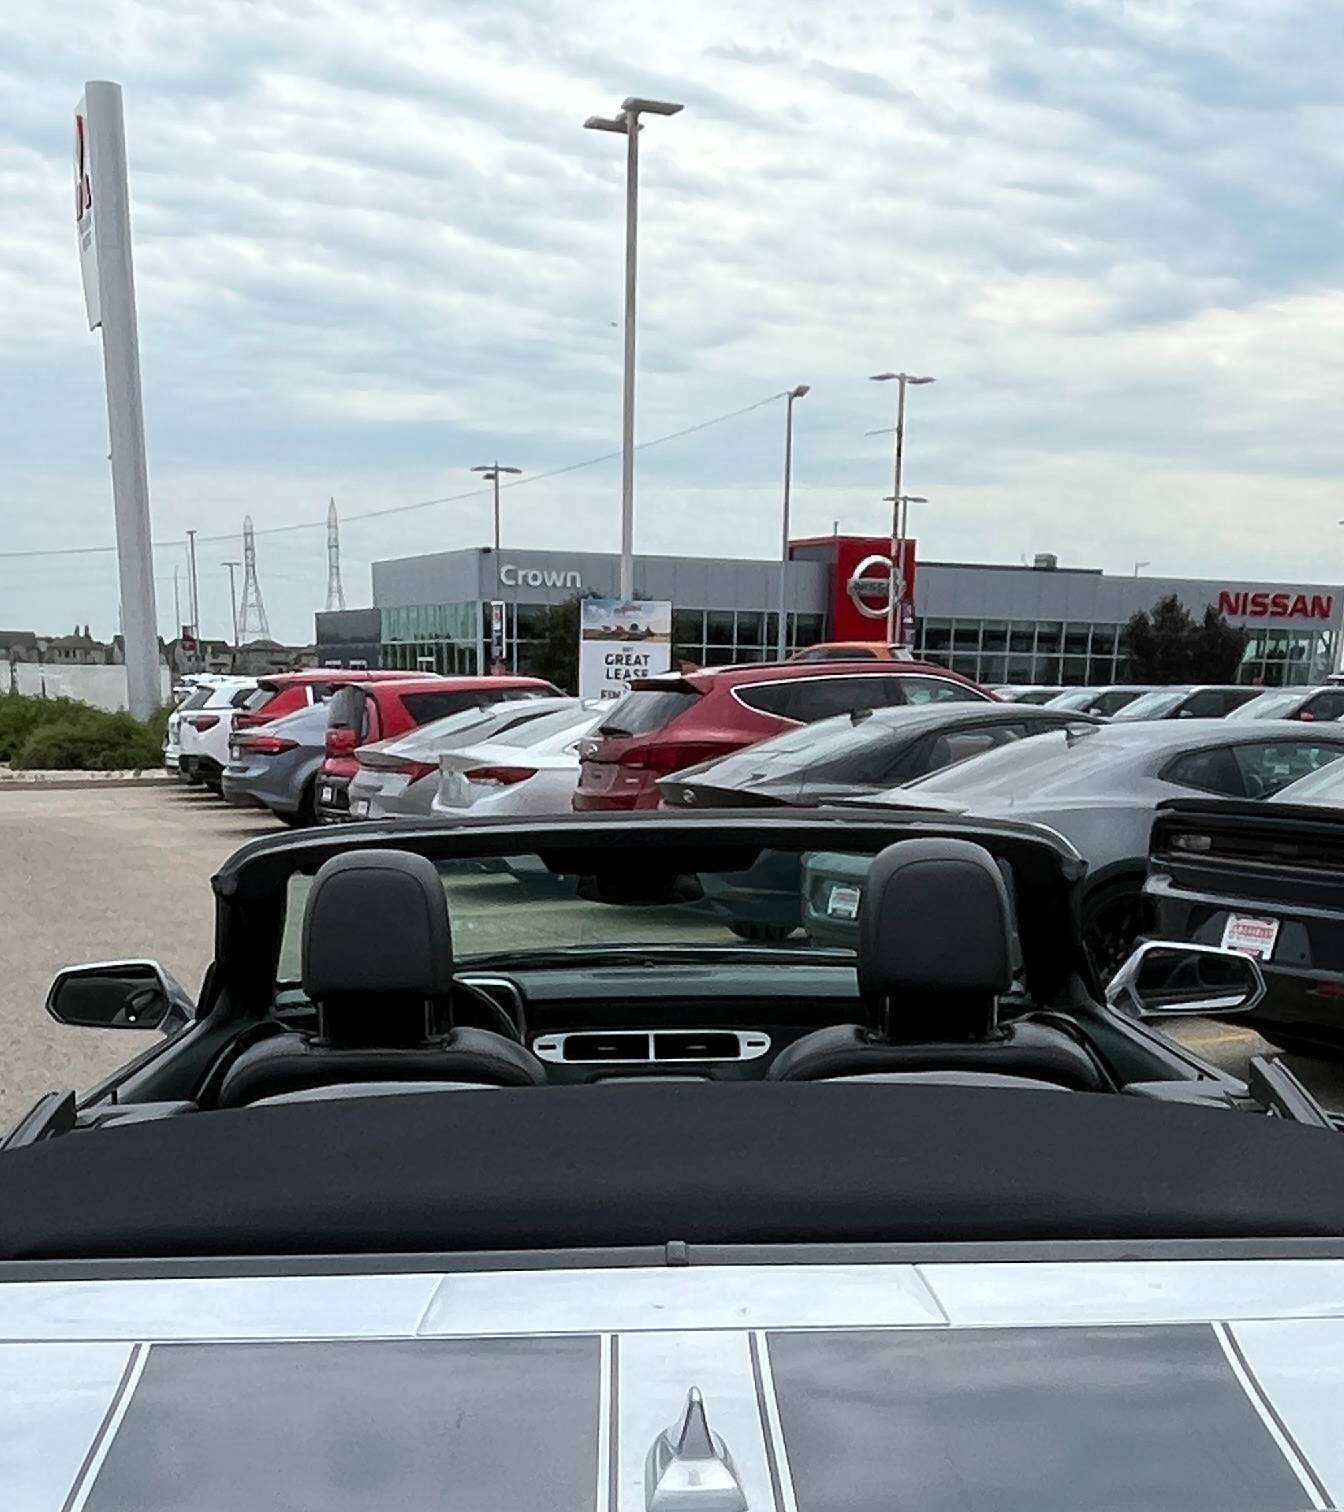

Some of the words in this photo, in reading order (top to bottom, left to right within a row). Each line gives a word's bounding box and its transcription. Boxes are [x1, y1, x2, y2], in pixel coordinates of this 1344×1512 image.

[500, 564, 581, 588] Crown
[1219, 591, 1332, 618] NISSAN
[604, 653, 650, 666] GREAT
